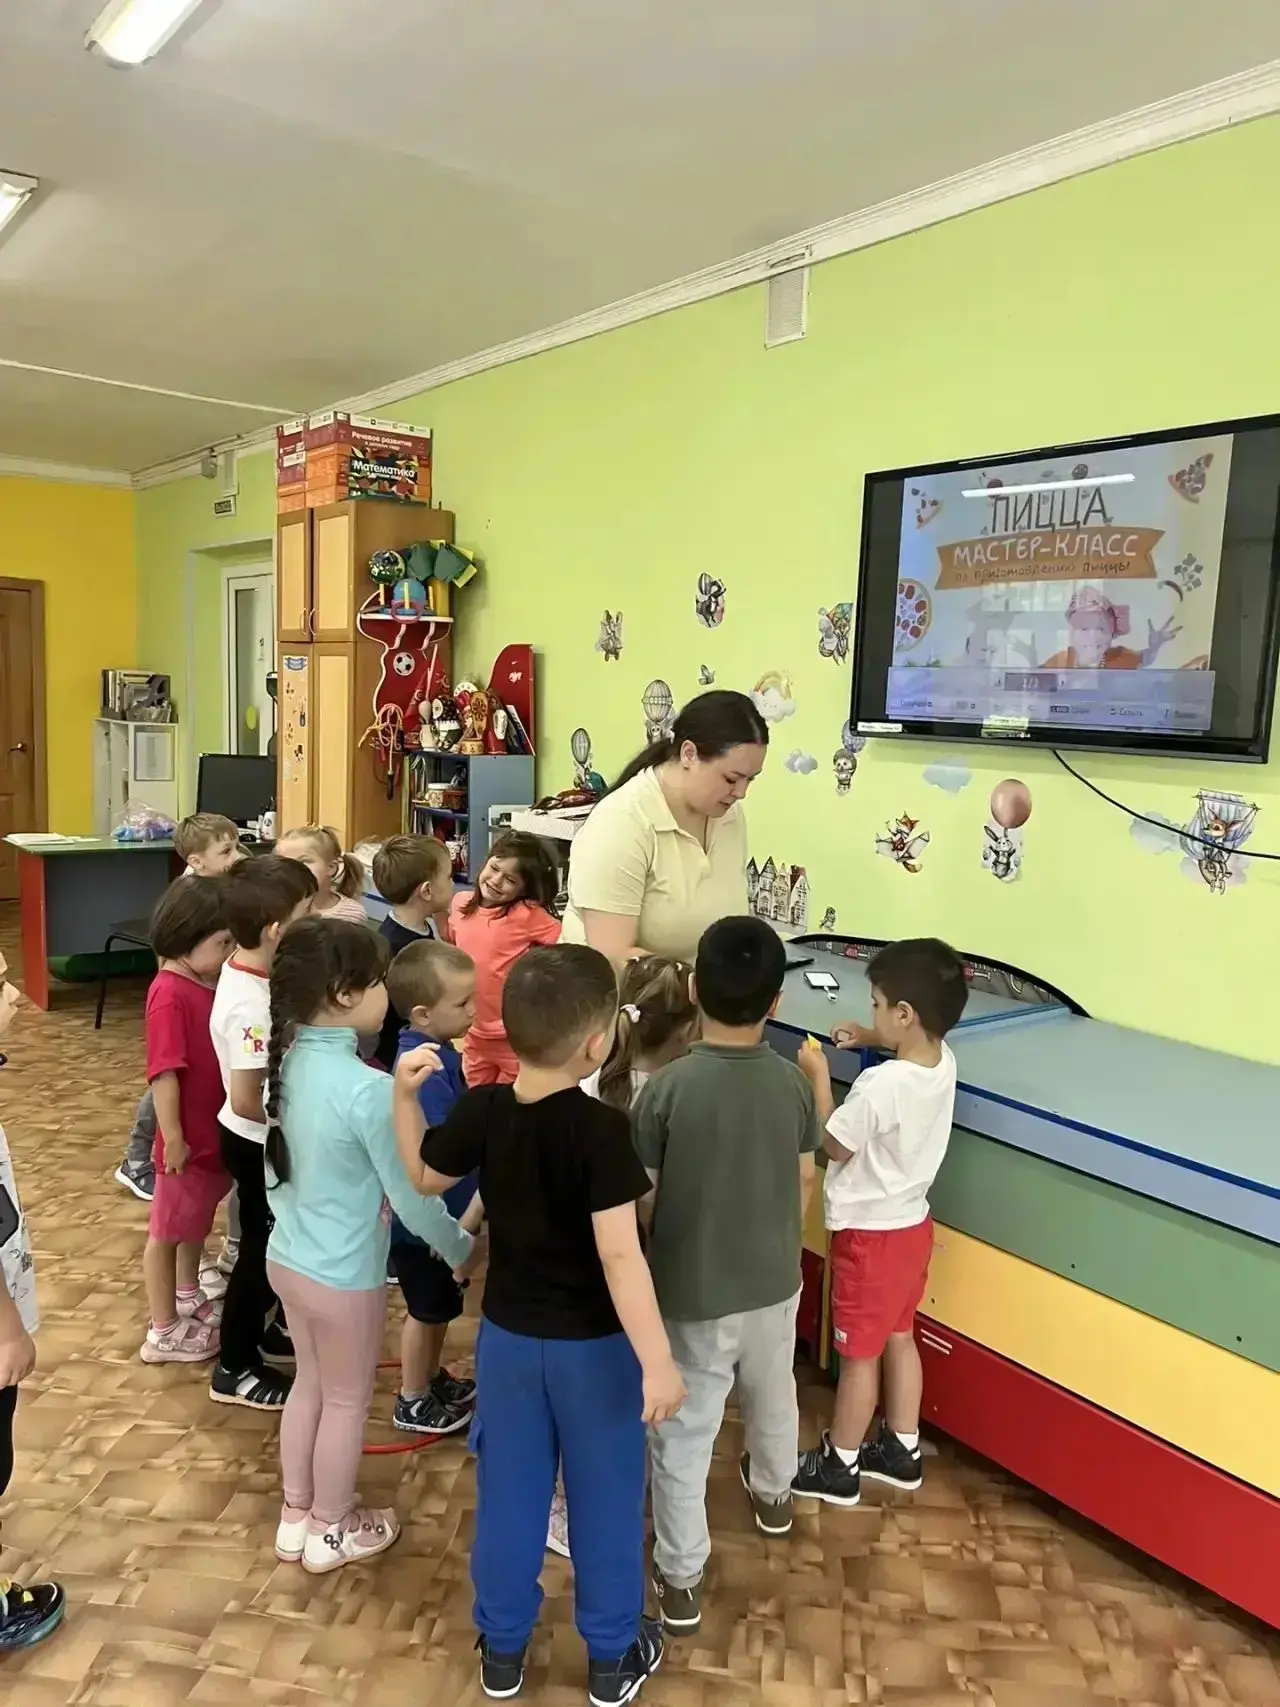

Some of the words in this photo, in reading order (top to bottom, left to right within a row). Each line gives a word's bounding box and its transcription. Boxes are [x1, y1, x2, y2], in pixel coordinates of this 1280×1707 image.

[353, 460, 415, 478] Математика
[991, 487, 1109, 533] ПИЦЦА
[953, 534, 1139, 567] МАСТЕР-КЛАСС
